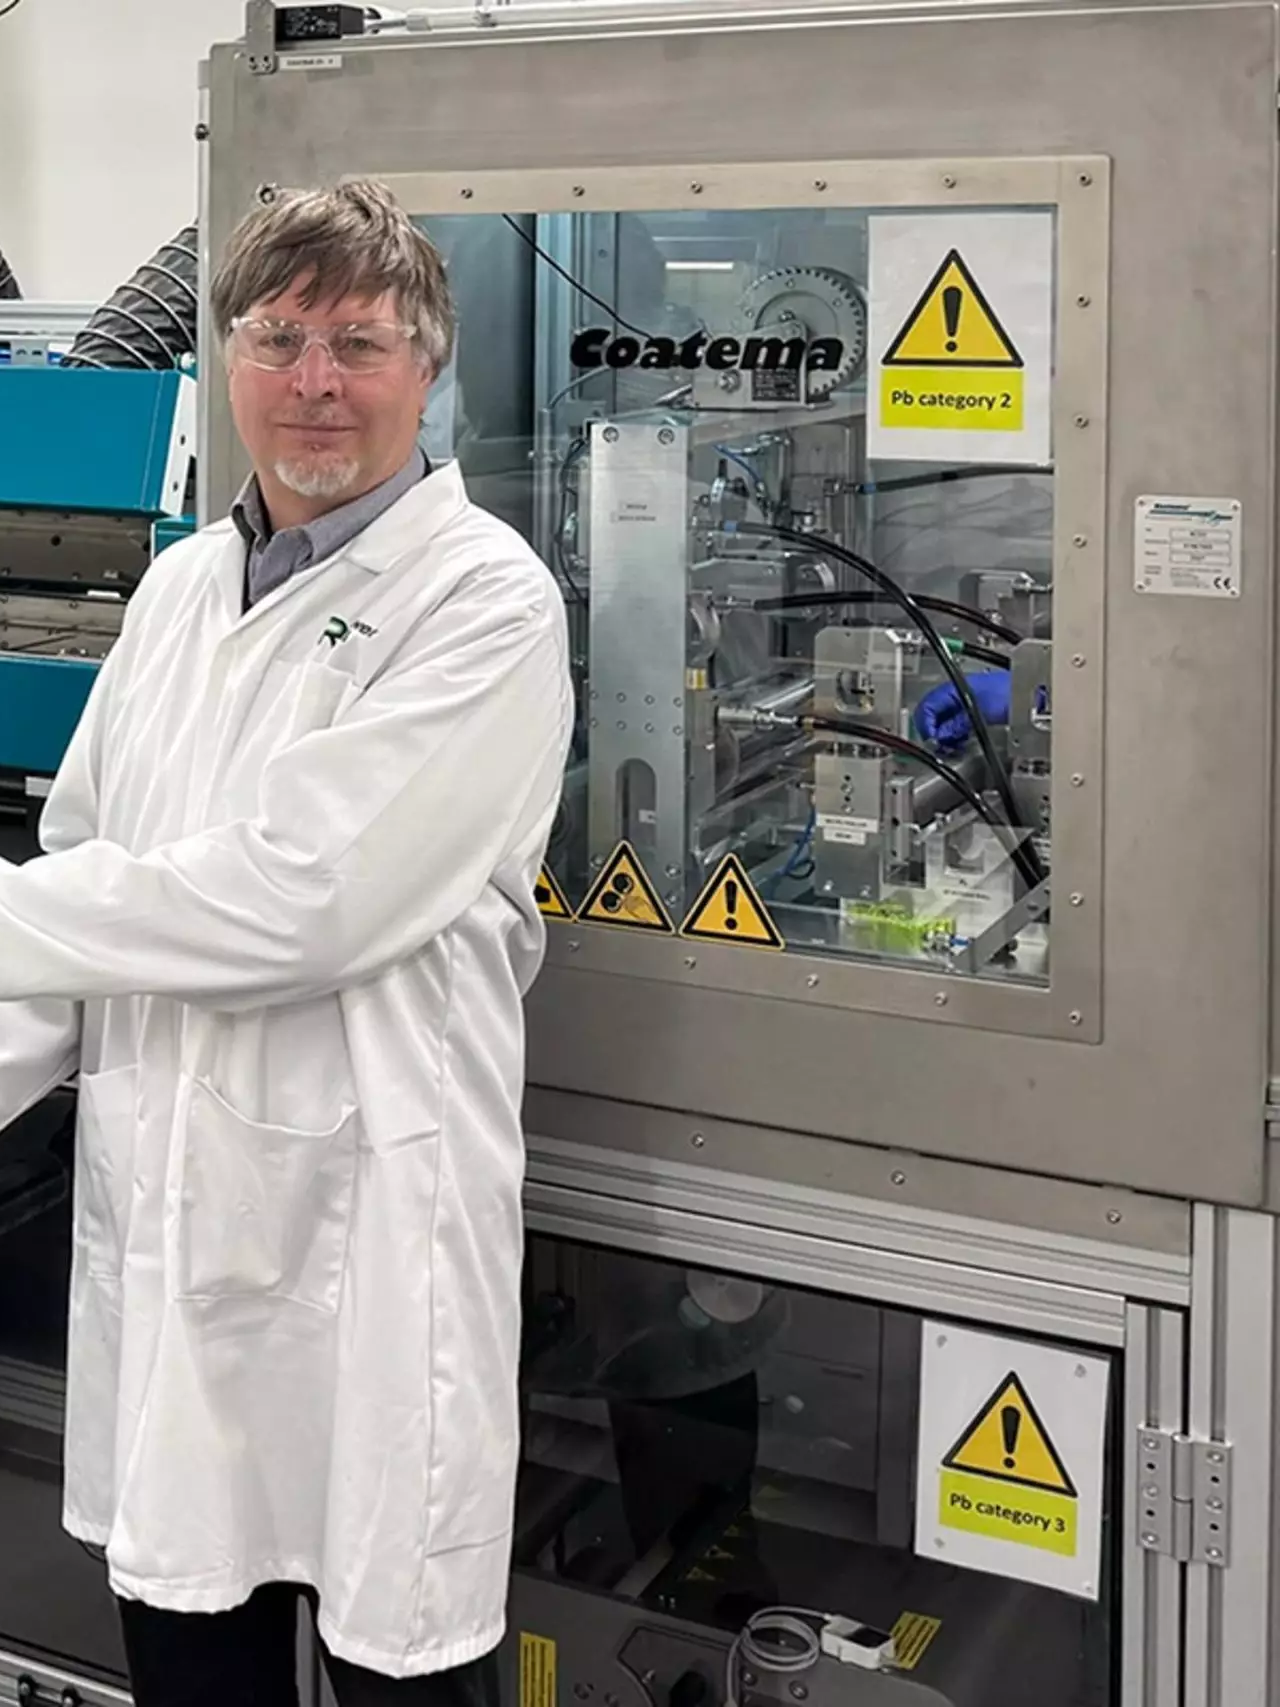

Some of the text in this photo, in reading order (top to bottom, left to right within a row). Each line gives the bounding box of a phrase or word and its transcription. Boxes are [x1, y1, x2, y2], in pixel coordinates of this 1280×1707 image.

[570, 328, 844, 371] Coatema
[891, 389, 1012, 410] Pb category 2
[950, 1492, 1066, 1532] Pb category 3
